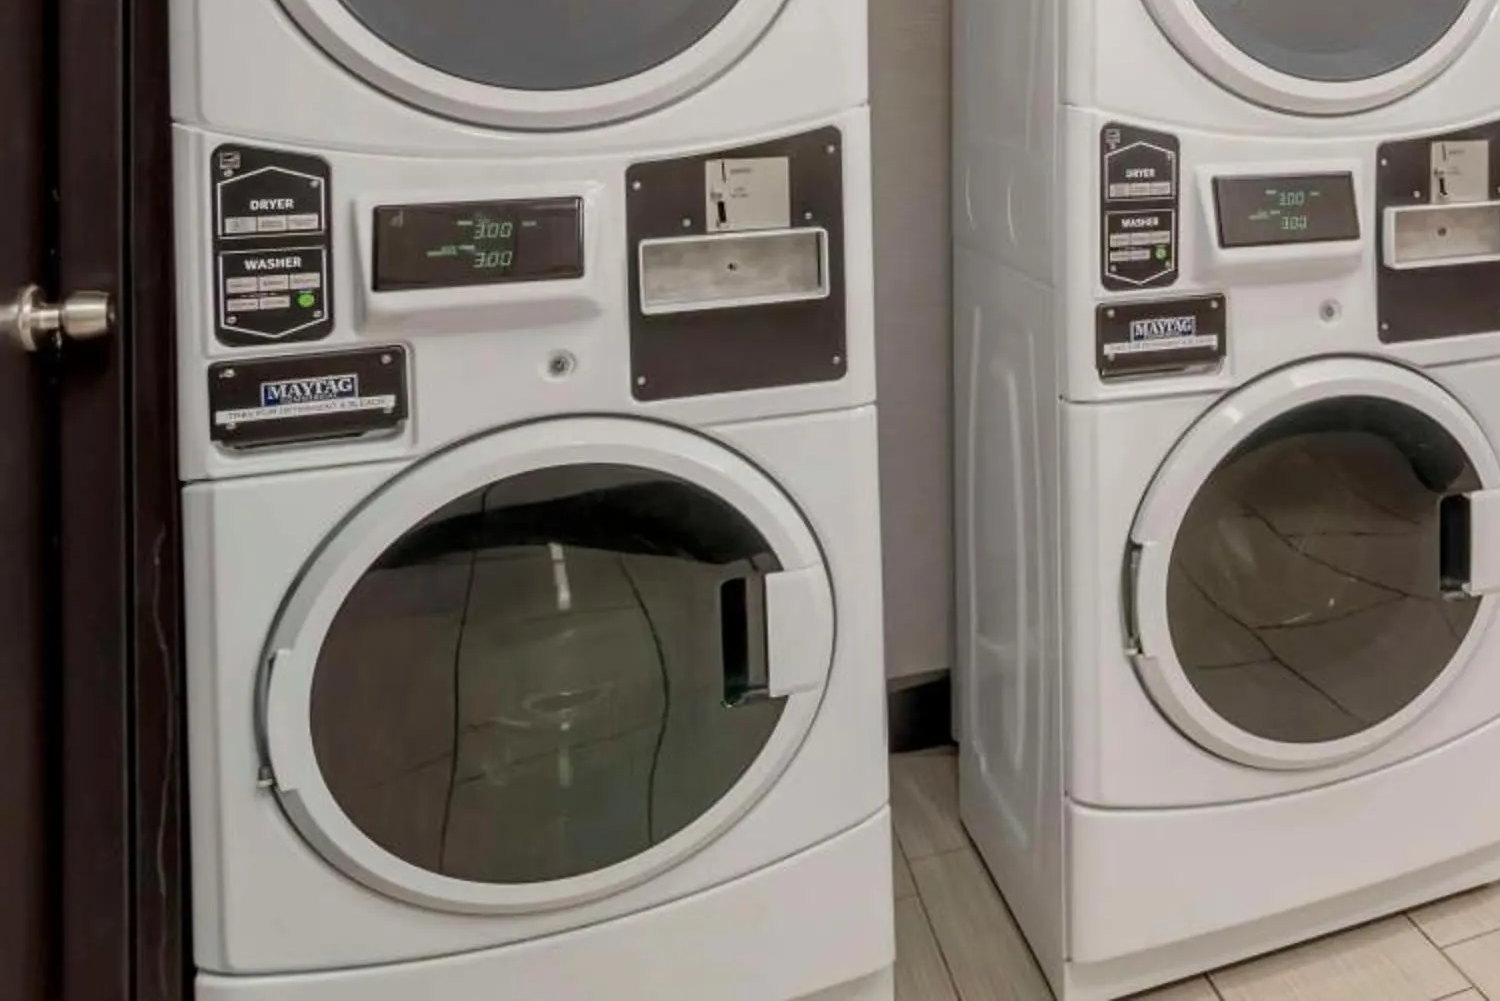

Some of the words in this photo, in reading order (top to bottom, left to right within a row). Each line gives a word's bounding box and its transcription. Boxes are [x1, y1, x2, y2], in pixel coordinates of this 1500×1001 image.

[249, 199, 295, 211] DRYER
[243, 256, 302, 271] WASHER
[1134, 319, 1193, 337] MAYTAG
[267, 377, 353, 401] MAYTAG
